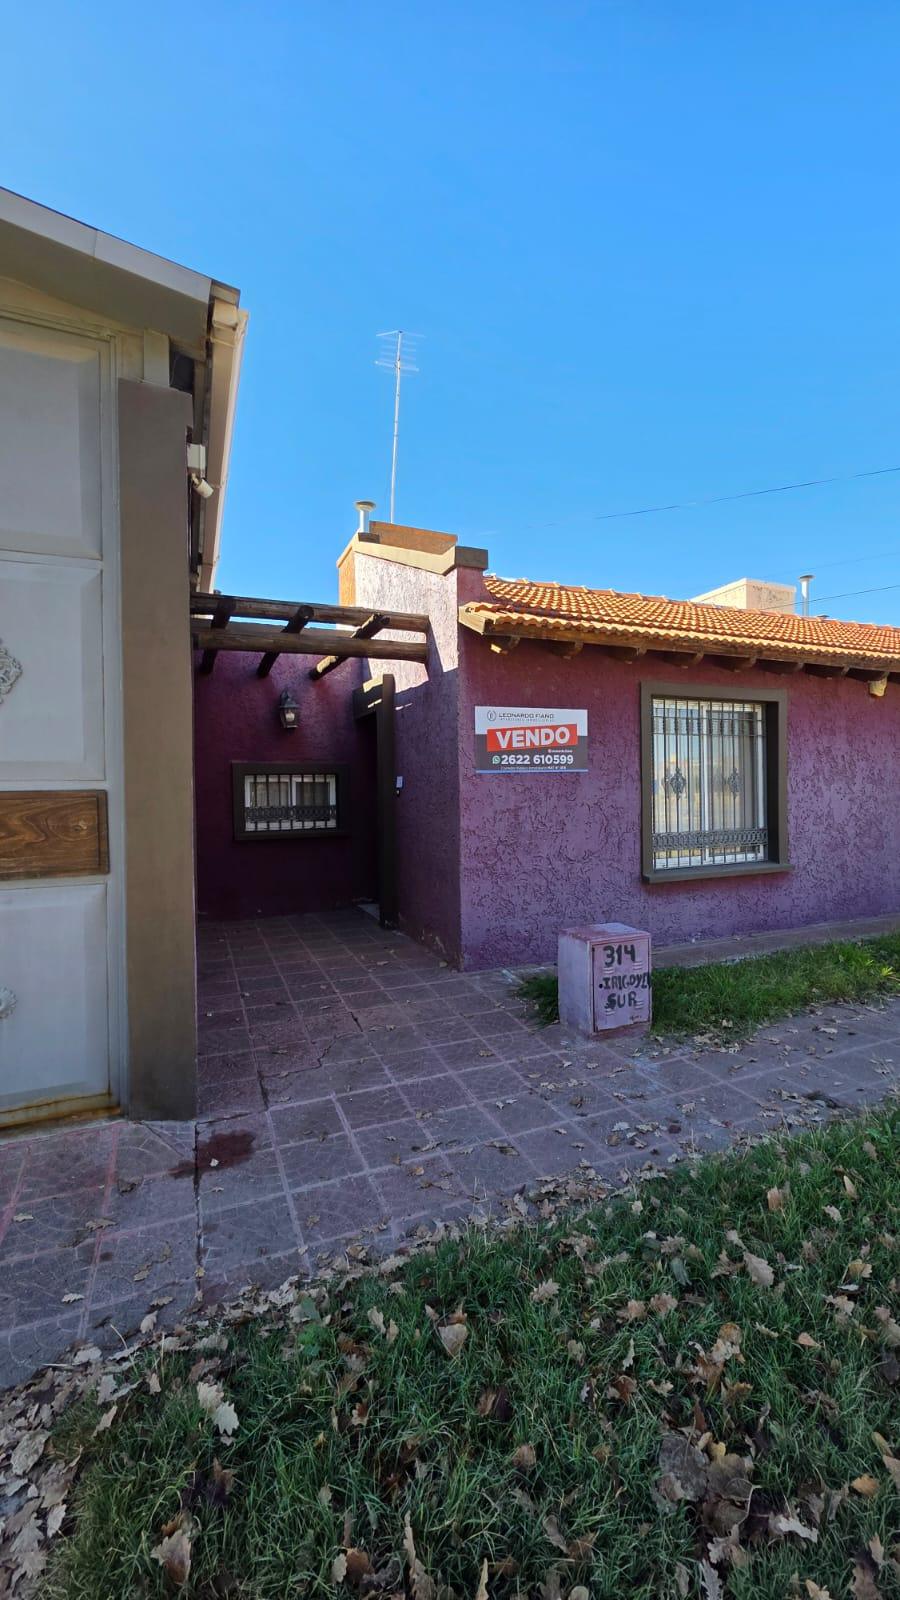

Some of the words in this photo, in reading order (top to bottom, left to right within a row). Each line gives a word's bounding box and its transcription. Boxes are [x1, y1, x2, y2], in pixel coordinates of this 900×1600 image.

[495, 726, 570, 749] VENDO
[501, 754, 530, 765] 2622
[533, 754, 574, 765] 610599
[602, 944, 636, 967] 314
[604, 991, 638, 1010] SUR
